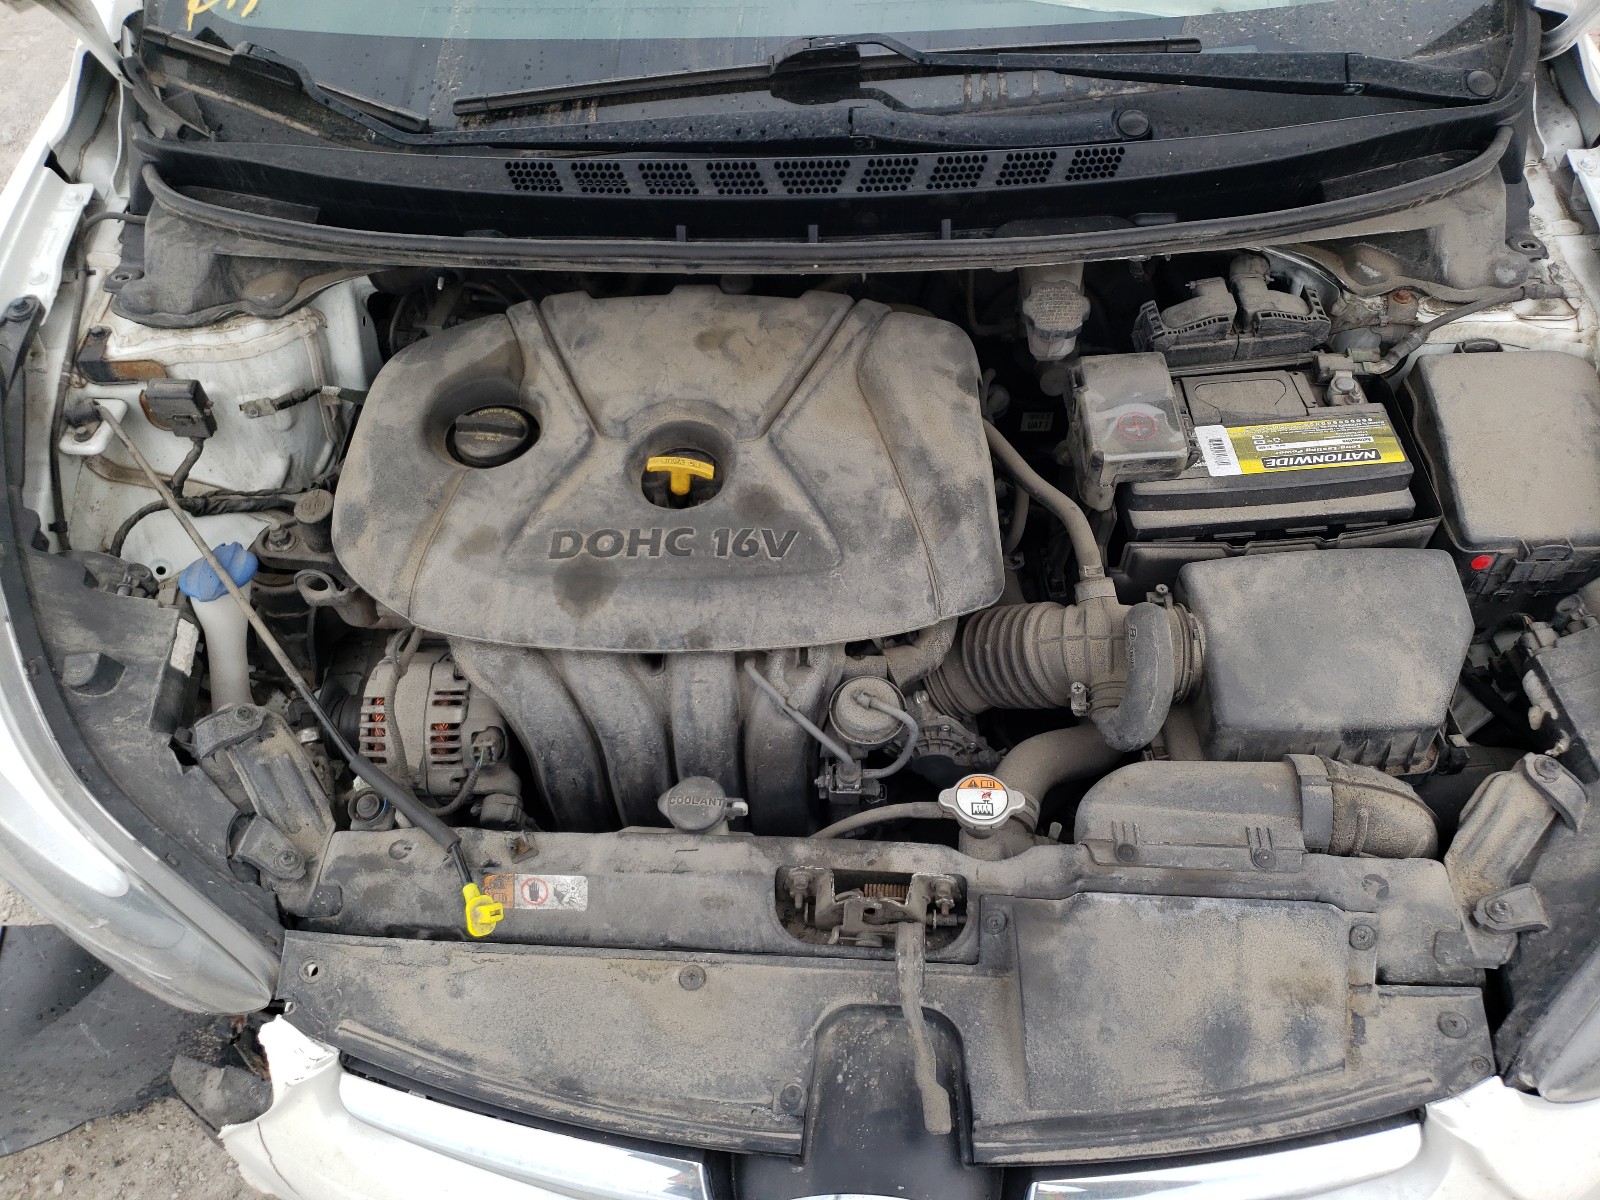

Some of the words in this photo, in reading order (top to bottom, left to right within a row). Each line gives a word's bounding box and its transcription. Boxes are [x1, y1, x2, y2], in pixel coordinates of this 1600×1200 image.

[1304, 445, 1337, 453] Lasting
[1265, 450, 1376, 467] NATIONWIDE
[549, 527, 696, 560] DOHC
[713, 527, 799, 560] 16V
[669, 796, 724, 807] COOLANT
